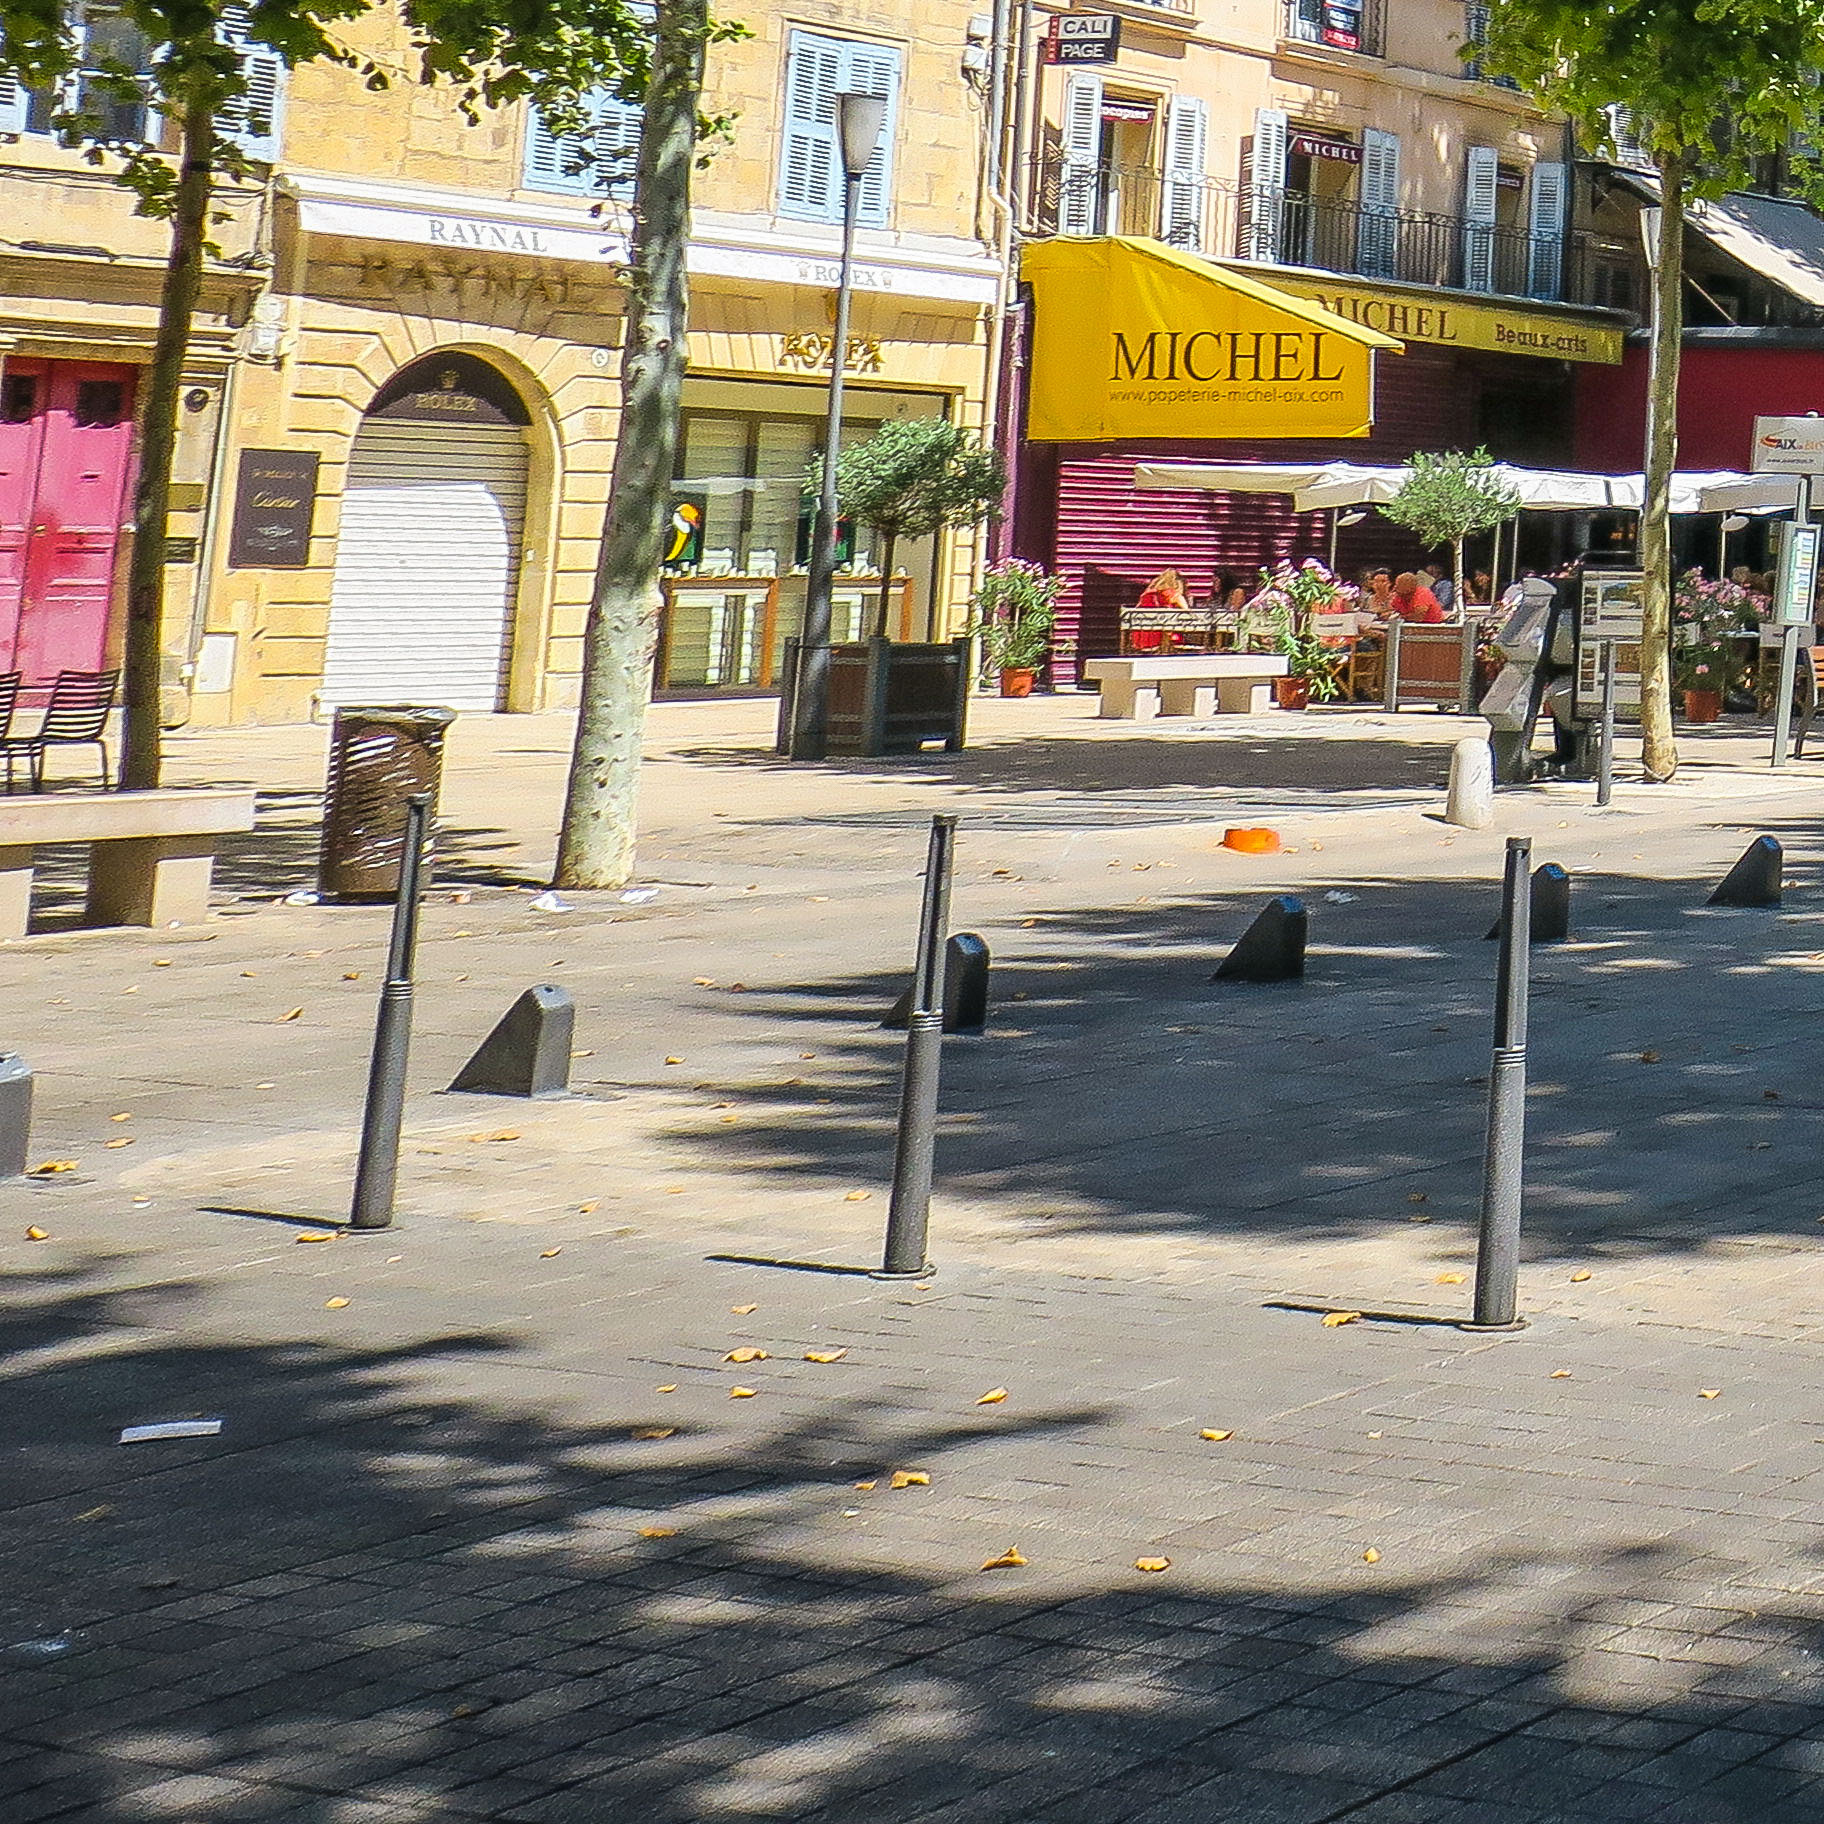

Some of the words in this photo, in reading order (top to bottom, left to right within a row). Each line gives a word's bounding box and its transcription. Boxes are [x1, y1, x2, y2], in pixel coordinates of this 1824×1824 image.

[1063, 20, 1107, 34] CALI
[1061, 43, 1106, 58] PAGE
[1303, 141, 1358, 161] MICHEL
[429, 219, 548, 252] RAYNAL
[814, 265, 878, 287] ROEX
[1317, 294, 1457, 340] MICHEL
[1495, 323, 1587, 353] Beaux-arts
[1108, 331, 1345, 382] MICHEL
[1774, 438, 1798, 450] AIX
